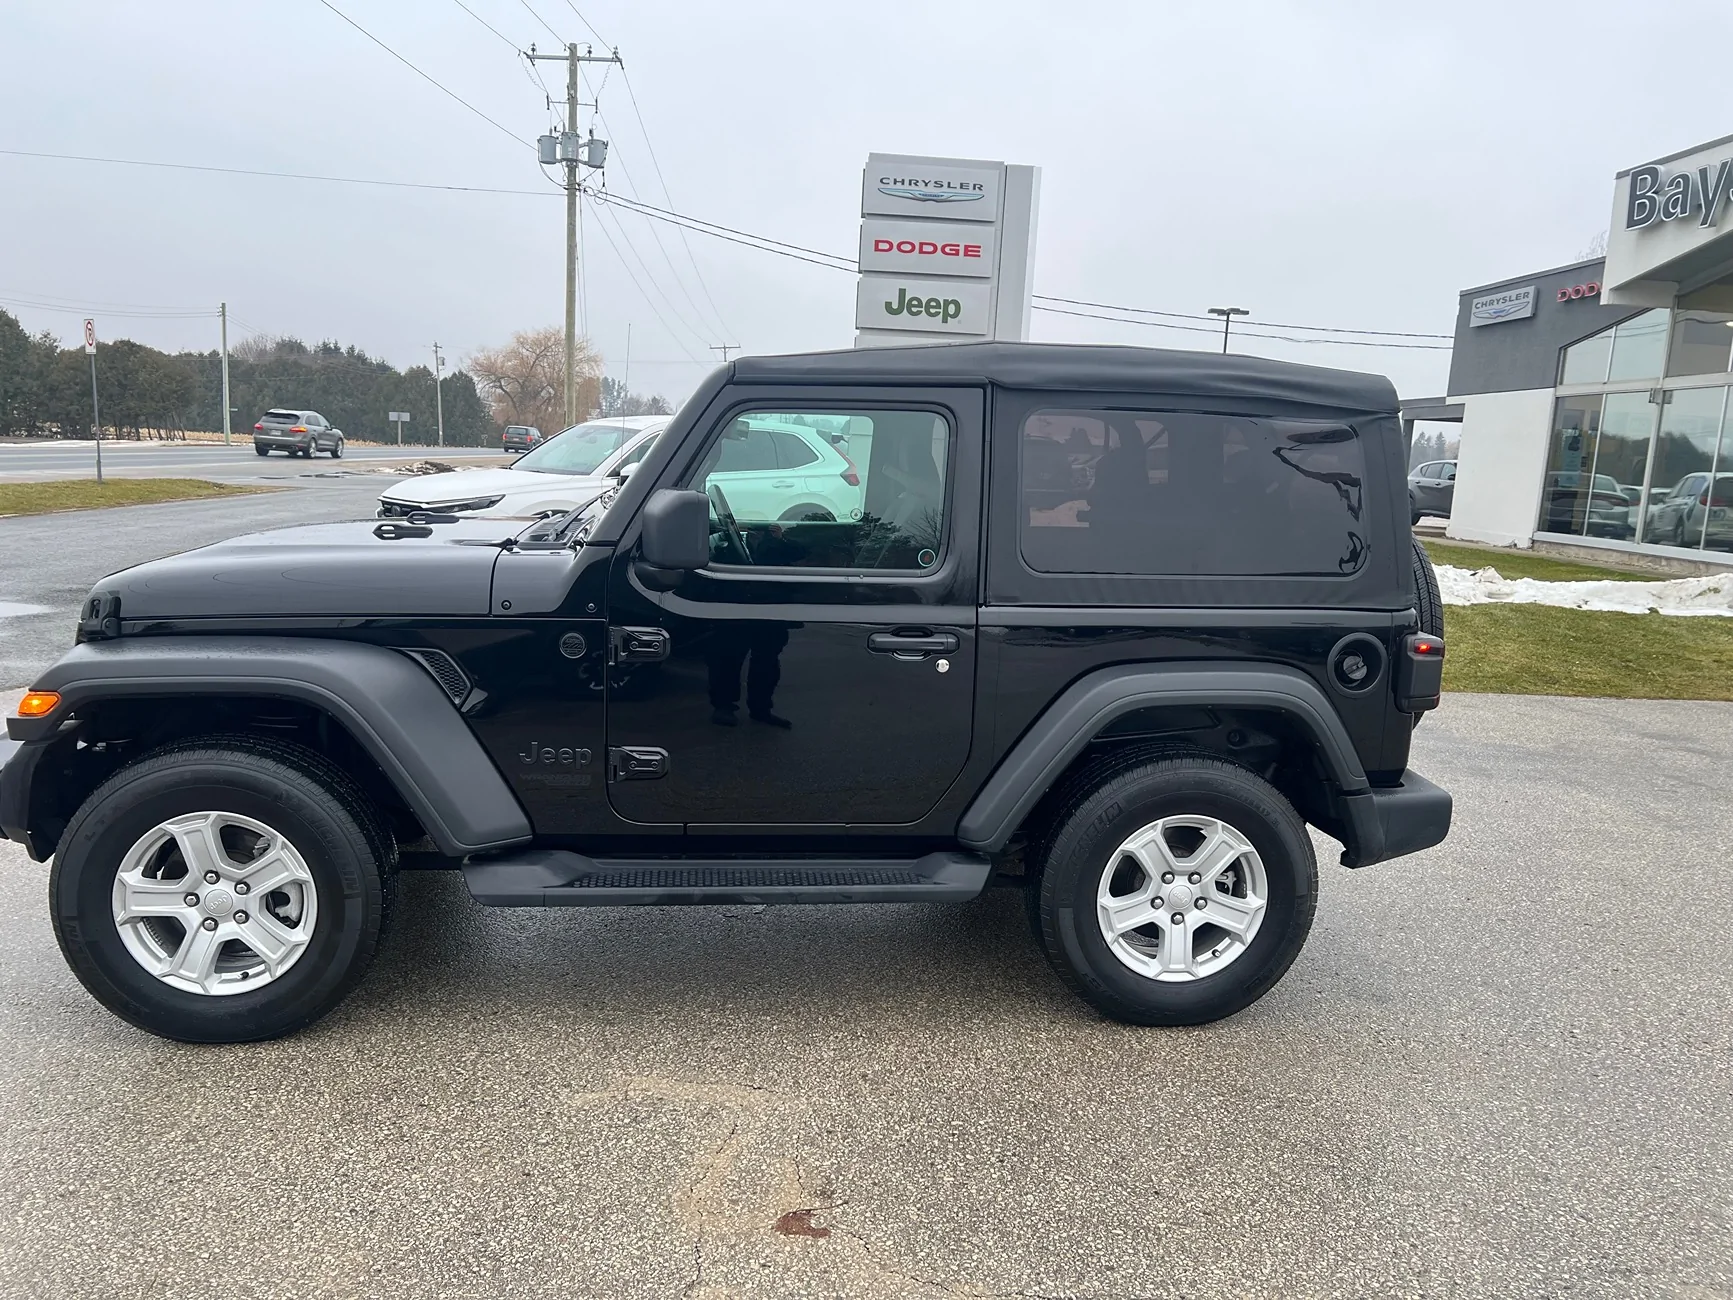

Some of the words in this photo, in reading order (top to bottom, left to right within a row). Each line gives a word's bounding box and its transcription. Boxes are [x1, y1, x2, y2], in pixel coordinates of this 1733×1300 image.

[879, 176, 984, 191] CHRYSLER
[1625, 157, 1733, 231] Bay
[874, 239, 982, 258] DODGE
[1474, 291, 1530, 310] CHRYSLER
[1557, 281, 1602, 302] DOD
[884, 287, 962, 324] Jeep
[519, 741, 592, 770] Jeep
